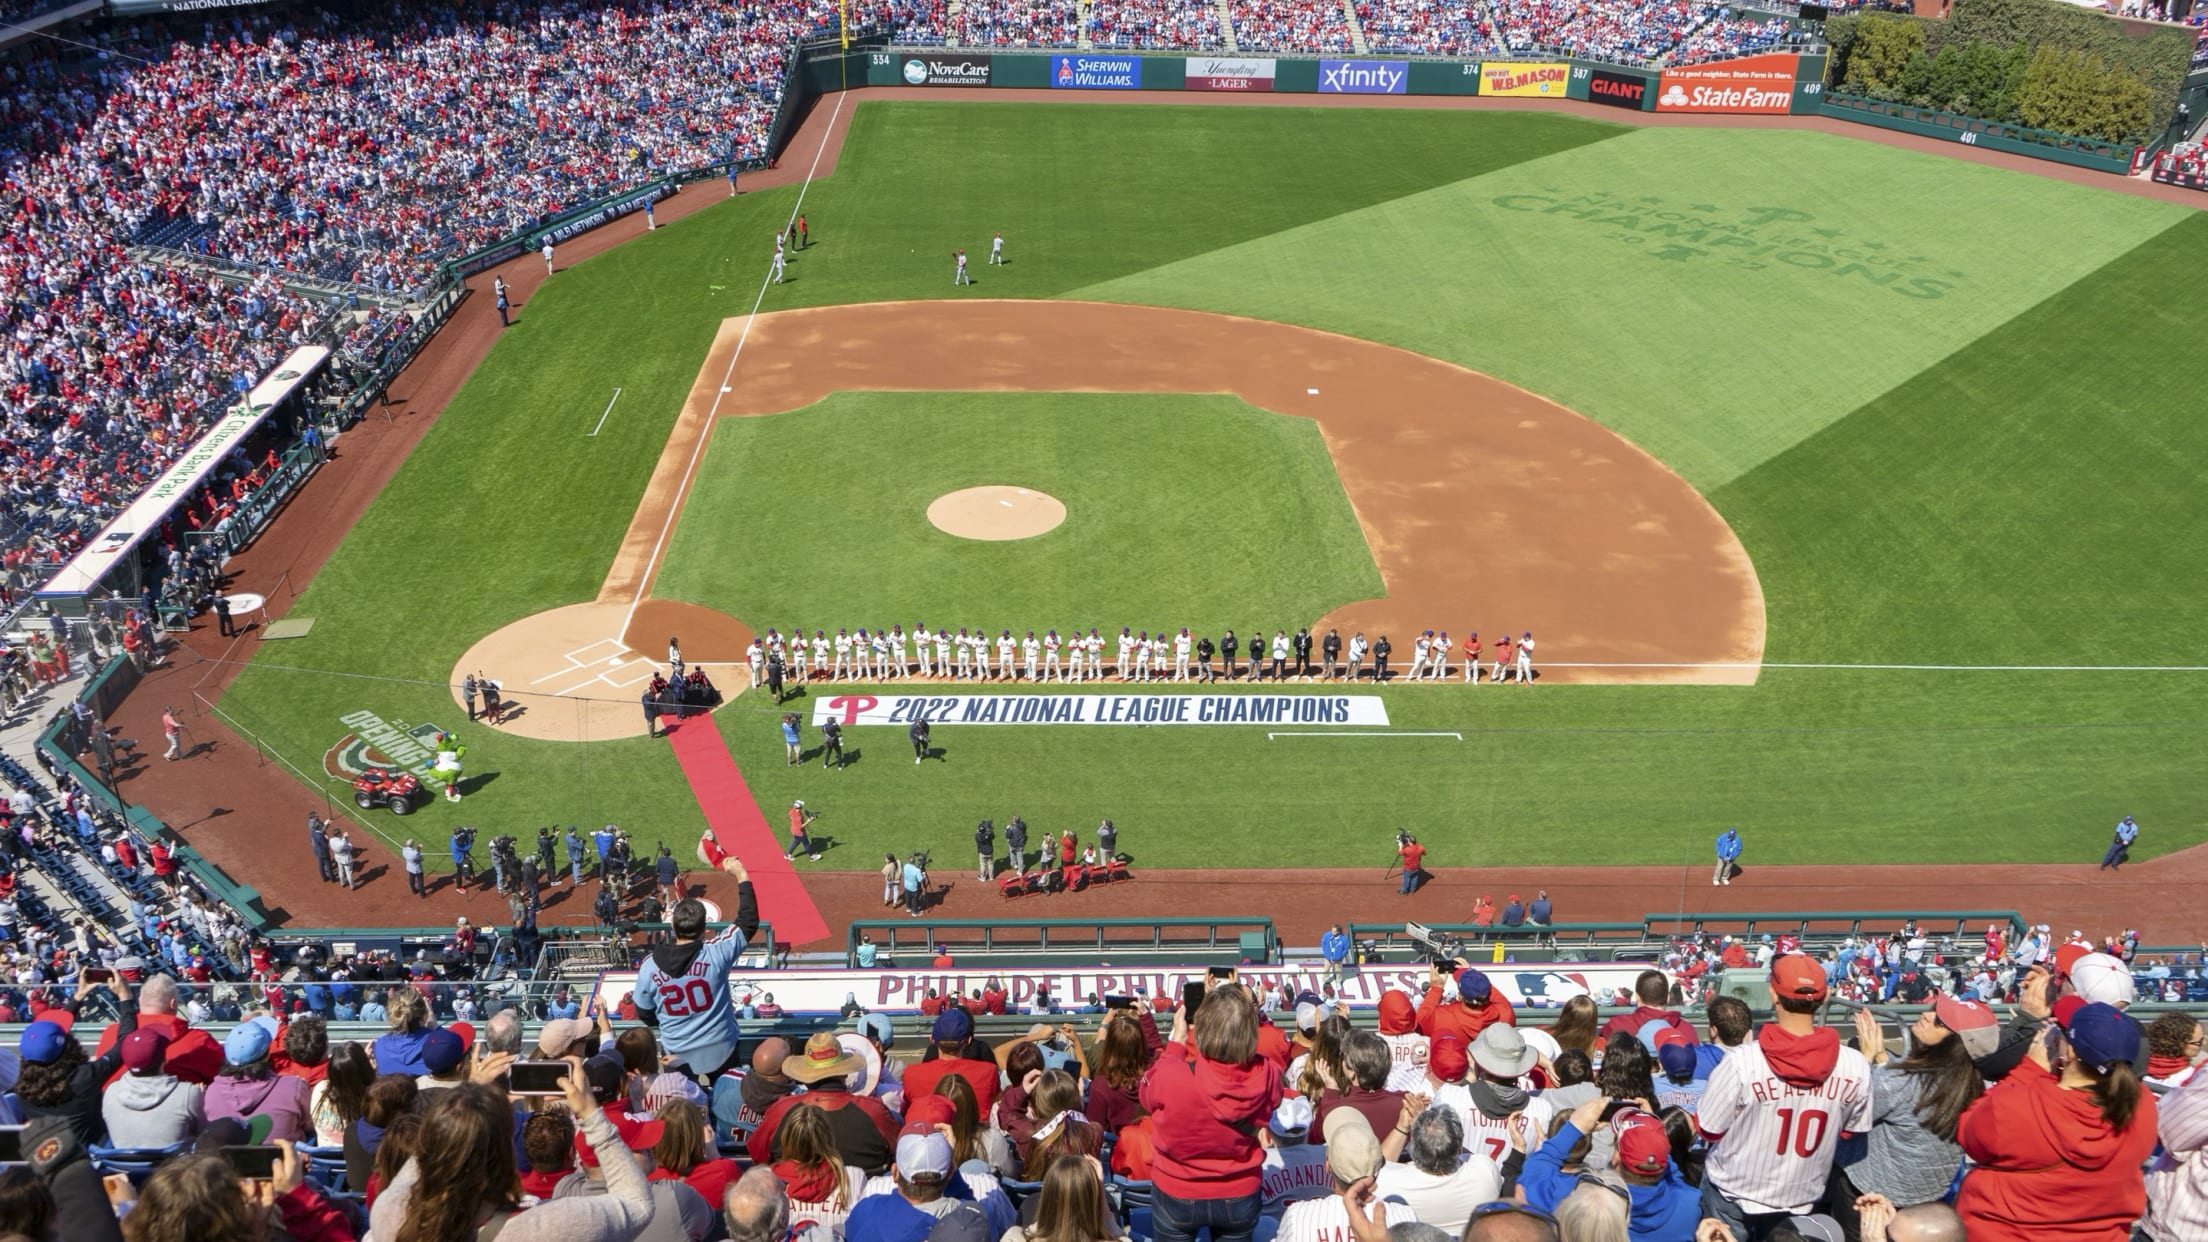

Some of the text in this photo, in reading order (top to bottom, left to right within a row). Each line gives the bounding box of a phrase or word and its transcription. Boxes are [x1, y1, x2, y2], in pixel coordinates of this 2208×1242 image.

[873, 55, 890, 65] 334
[1076, 59, 1131, 73] SHERWIN
[1203, 59, 1259, 77] Yuengling
[928, 62, 989, 76] NovaCare
[1463, 64, 1479, 76] 374
[1573, 67, 1588, 80] 387
[929, 77, 987, 85] REHABILITATION
[1211, 79, 1248, 89] LAGER
[1324, 63, 1403, 92] xfinity
[1591, 79, 1645, 99] GIANT
[1803, 83, 1821, 95] 409
[1960, 131, 1977, 144] 401
[617, 201, 633, 215] MLB
[554, 212, 607, 242] MLB NETWORK
[1492, 195, 1957, 299] CHAMPIONS
[150, 420, 247, 499] Citizens Bank Park
[828, 694, 1350, 726] P 2022 NATIONAL LEAGUE CHAMPIONS
[339, 709, 432, 766] OPENING
[659, 978, 713, 1017] 20
[1658, 1091, 1700, 1105] TURNE
[1776, 1108, 1829, 1158] 10
[1485, 1137, 1506, 1161] 7
